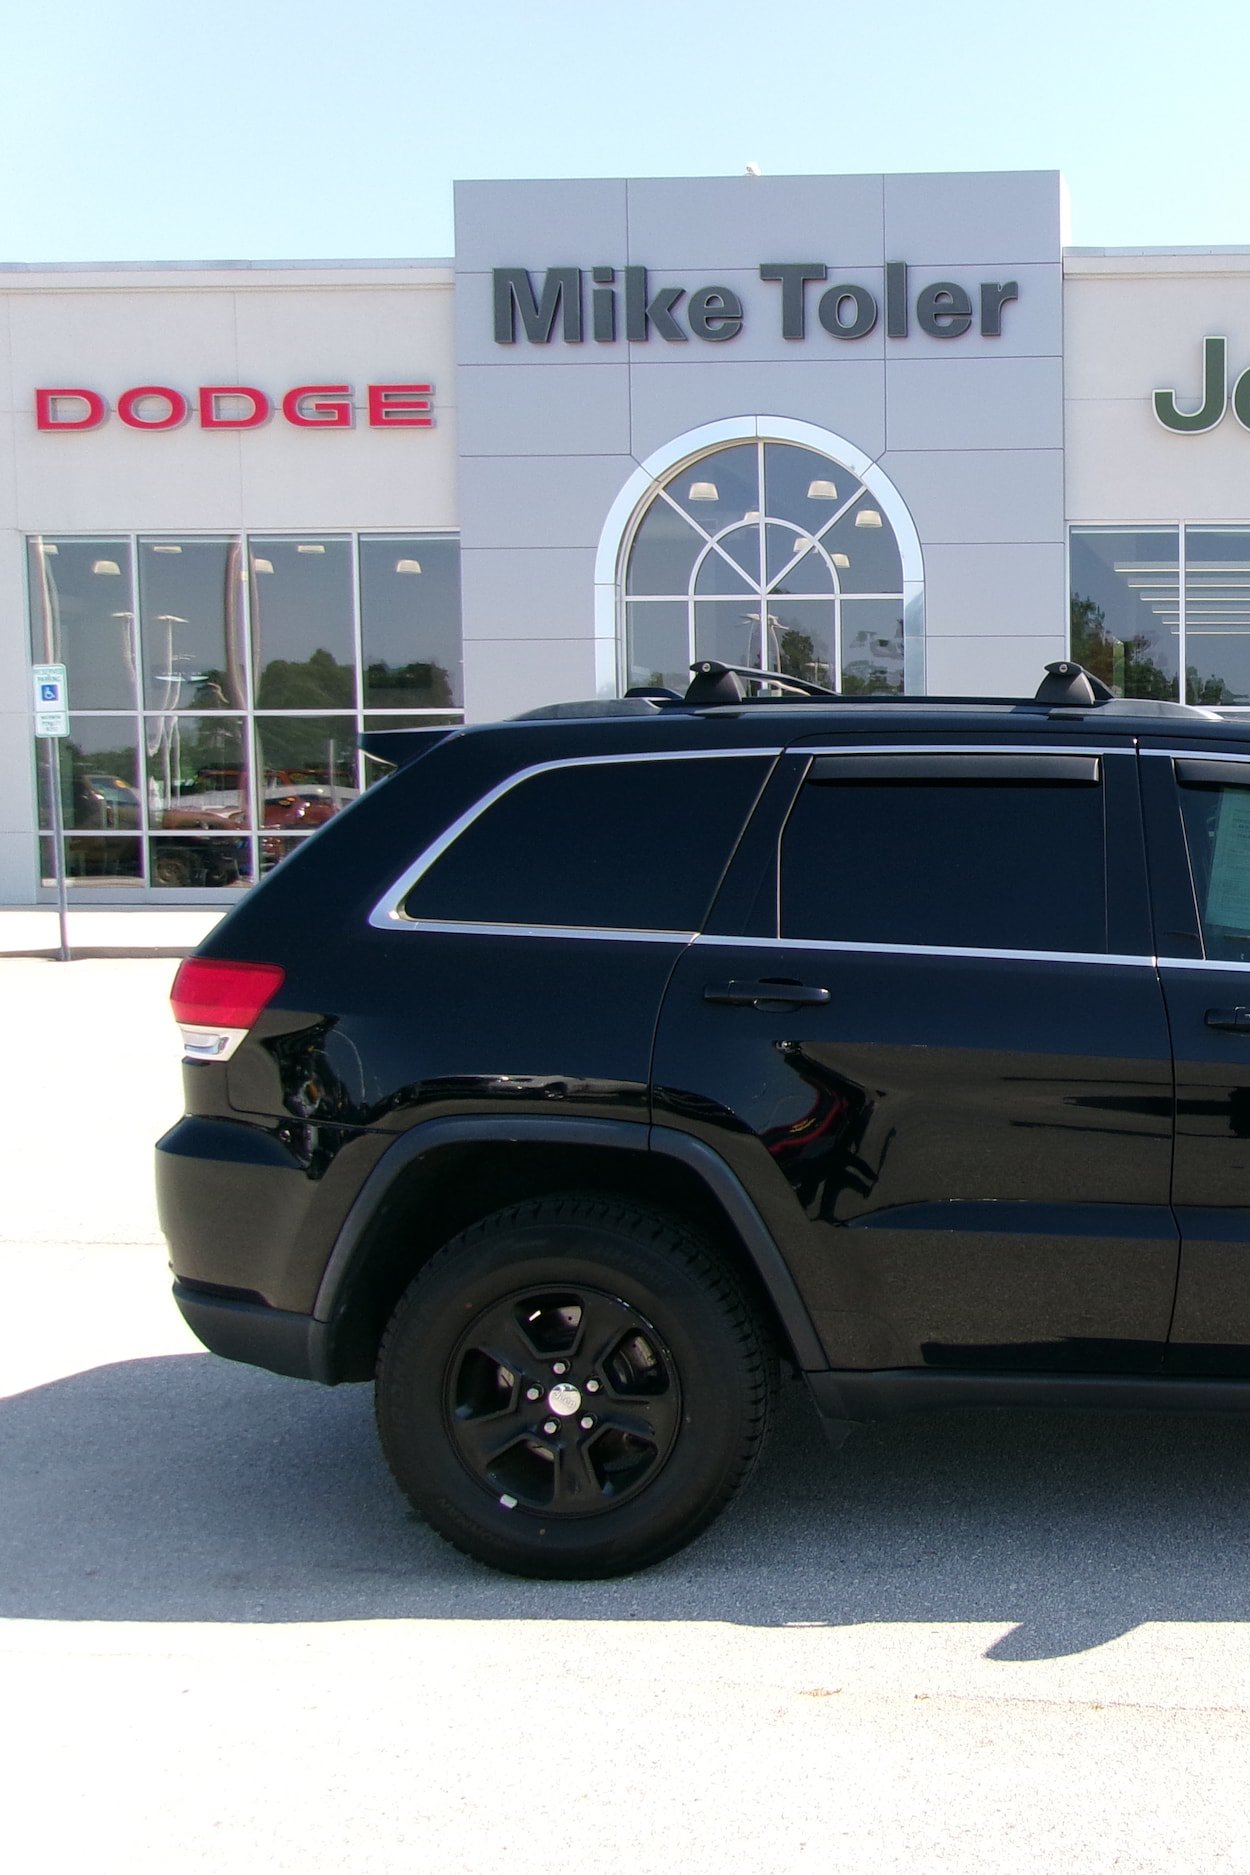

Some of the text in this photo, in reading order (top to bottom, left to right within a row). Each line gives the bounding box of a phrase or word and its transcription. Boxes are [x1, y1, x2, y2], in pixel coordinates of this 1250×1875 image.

[492, 260, 1018, 345] Mike Toler
[35, 383, 435, 431] DODGE
